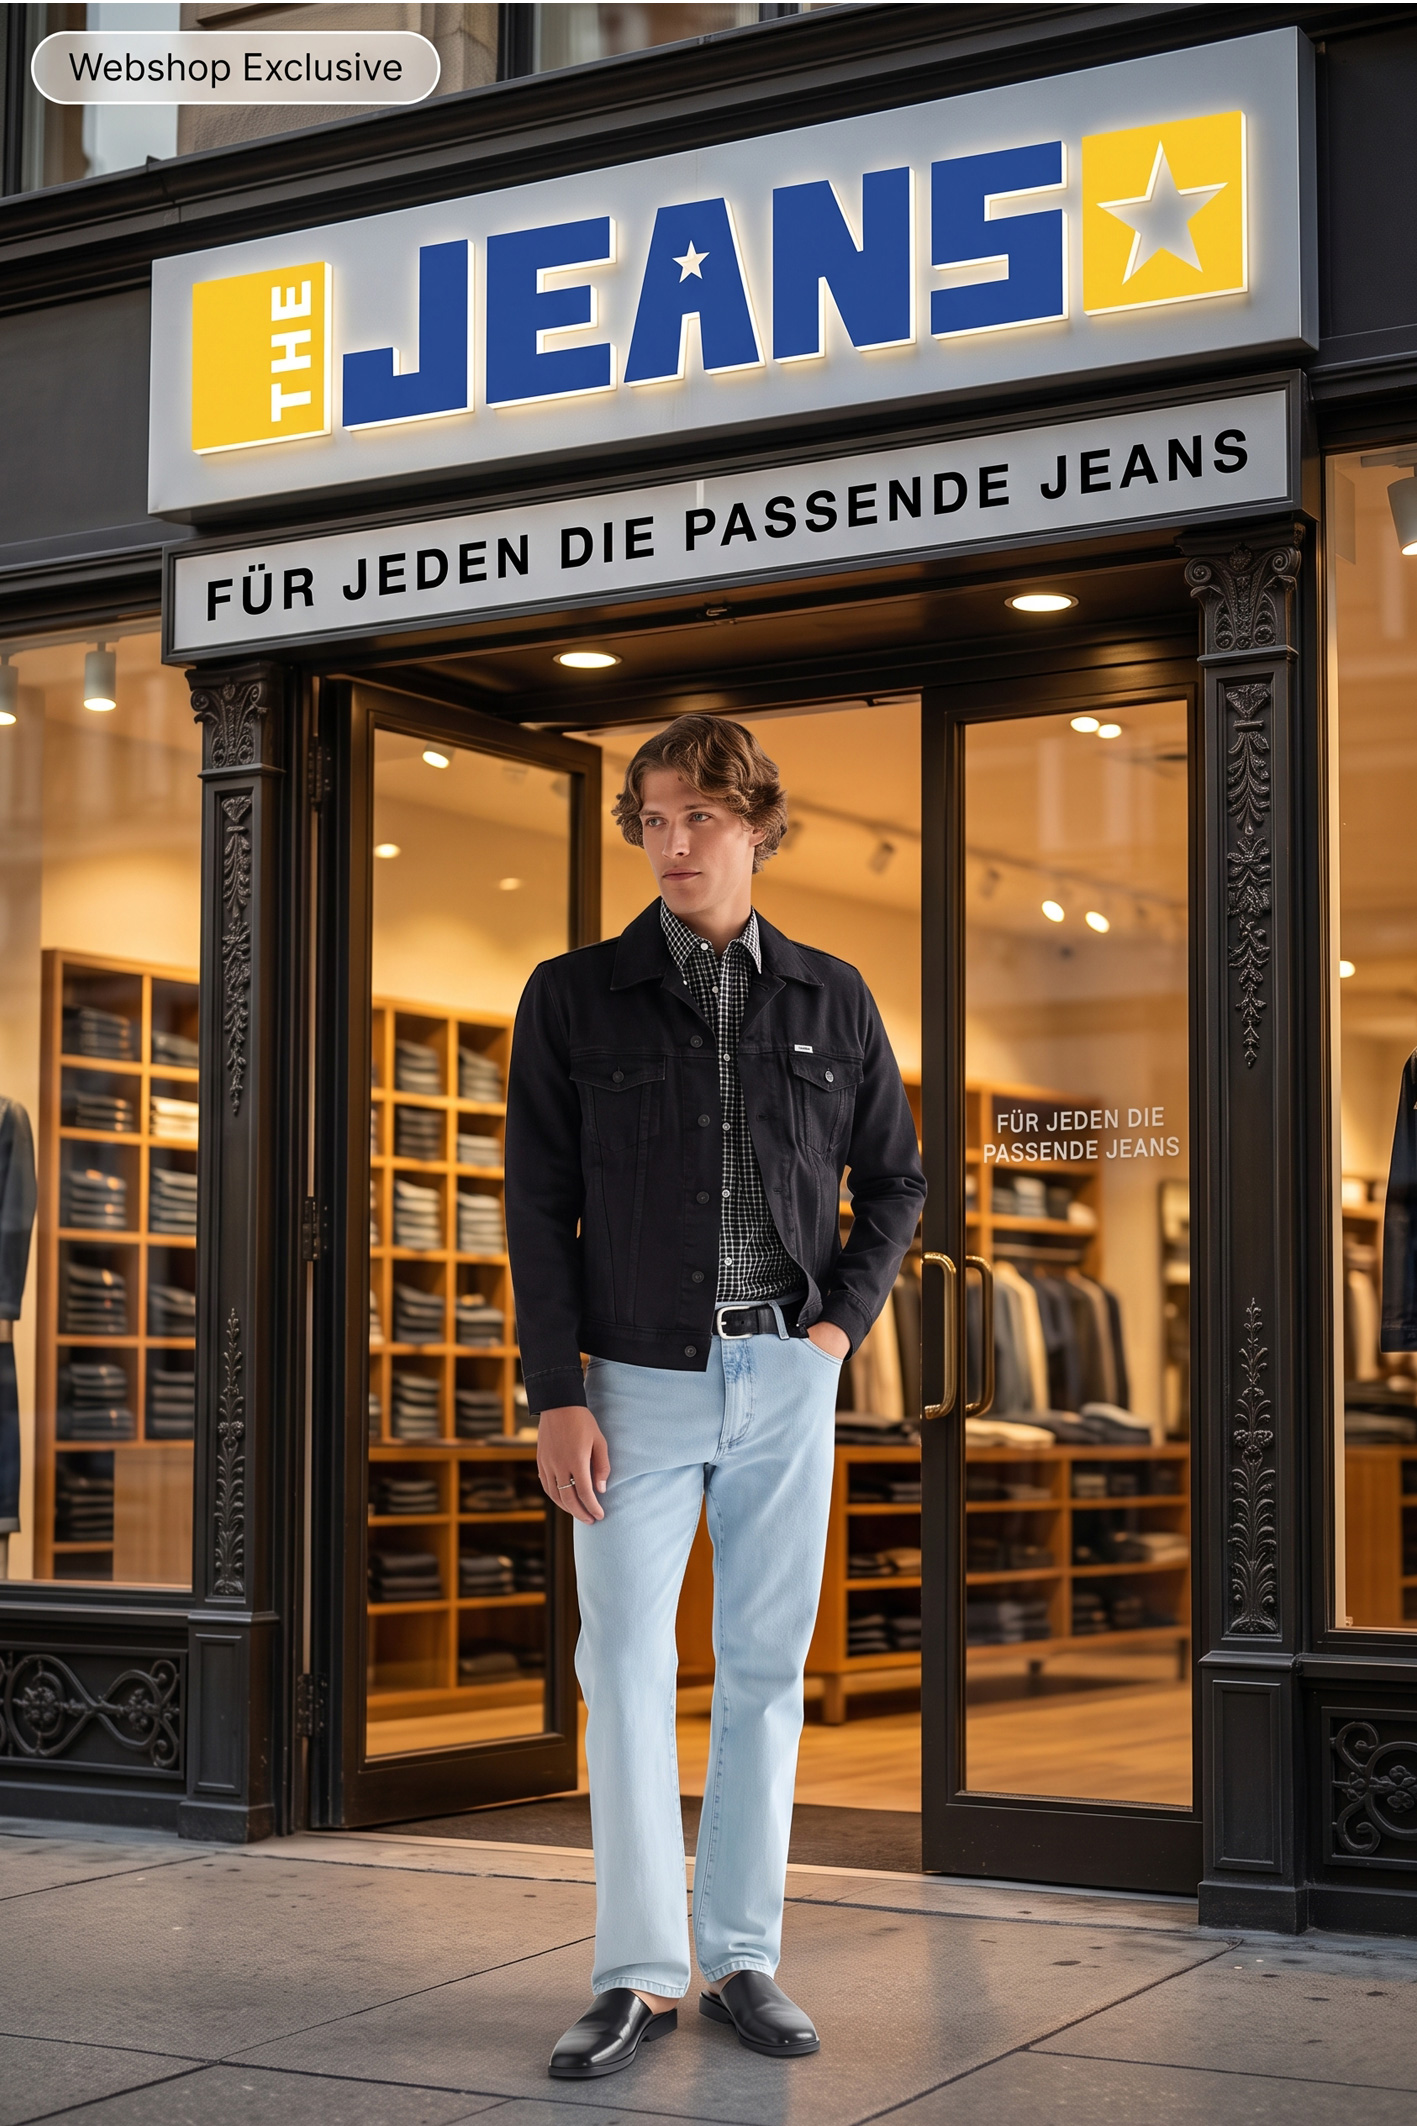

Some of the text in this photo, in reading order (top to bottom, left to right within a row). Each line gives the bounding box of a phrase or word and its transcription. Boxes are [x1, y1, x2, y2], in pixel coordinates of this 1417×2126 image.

[271, 141, 1066, 430] THE JEANS
[206, 429, 1249, 621] FÜR JEDEN DIE PASSENDE JEANS
[983, 1136, 1180, 1164] PASSENDE JEANS
[997, 1106, 1165, 1134] FÜR JEDEN DIE
